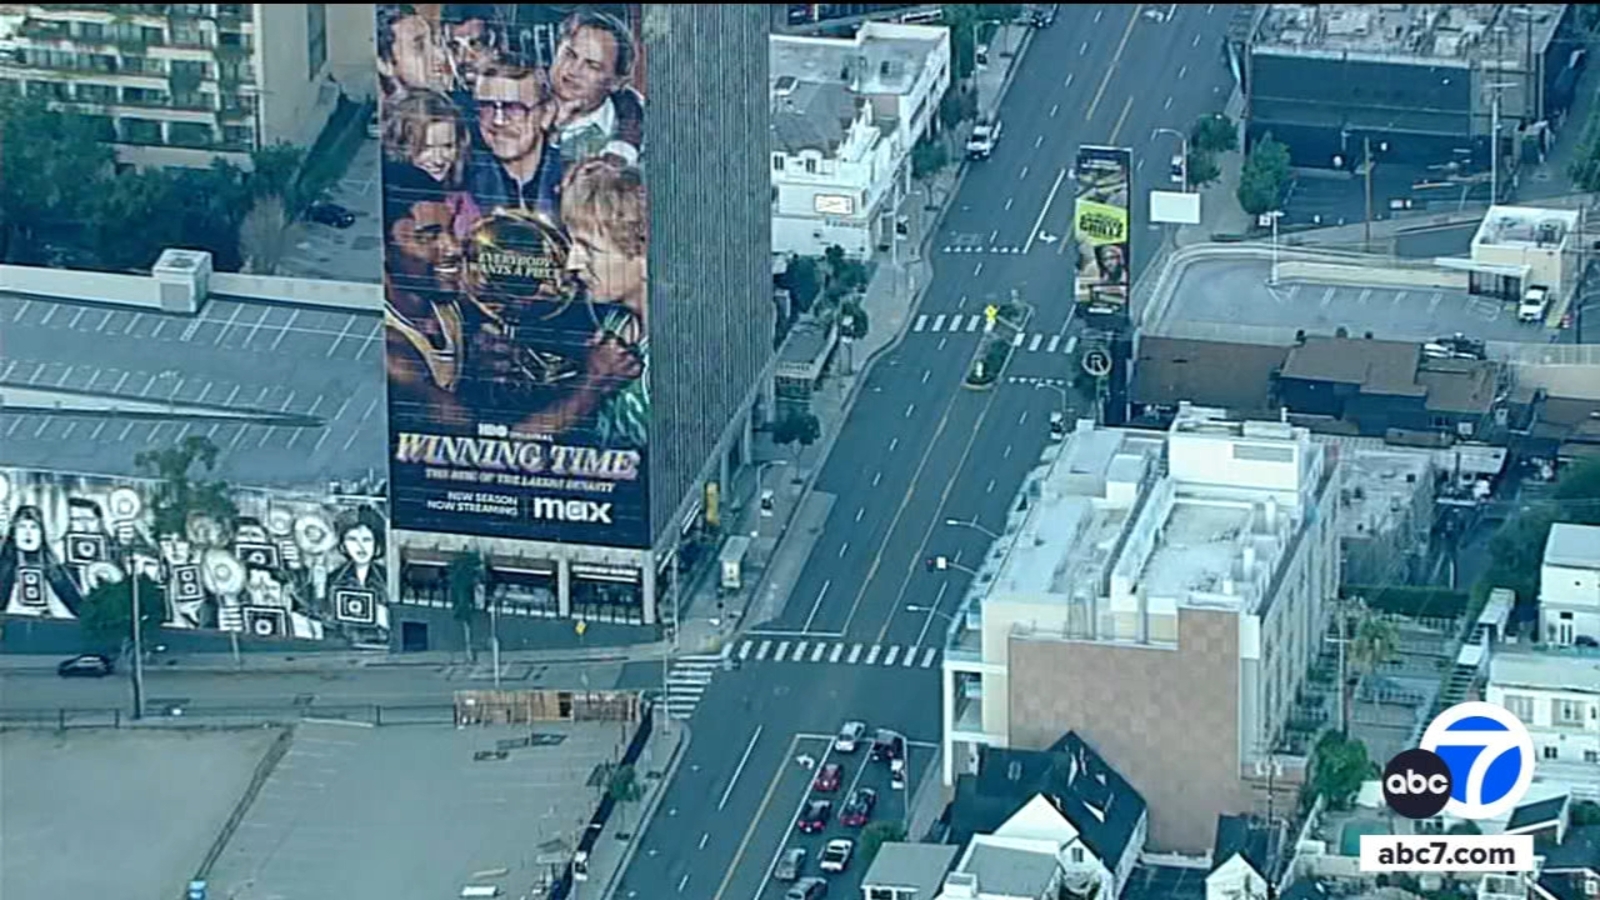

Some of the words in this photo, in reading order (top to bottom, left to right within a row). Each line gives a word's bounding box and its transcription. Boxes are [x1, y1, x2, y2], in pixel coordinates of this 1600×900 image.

[395, 432, 543, 473] WINNING
[549, 444, 641, 480] TIME
[448, 491, 472, 501] NEW
[476, 493, 517, 504] SEASON
[427, 500, 455, 511] NOW
[457, 502, 518, 516] STREAMING
[534, 498, 612, 523] max
